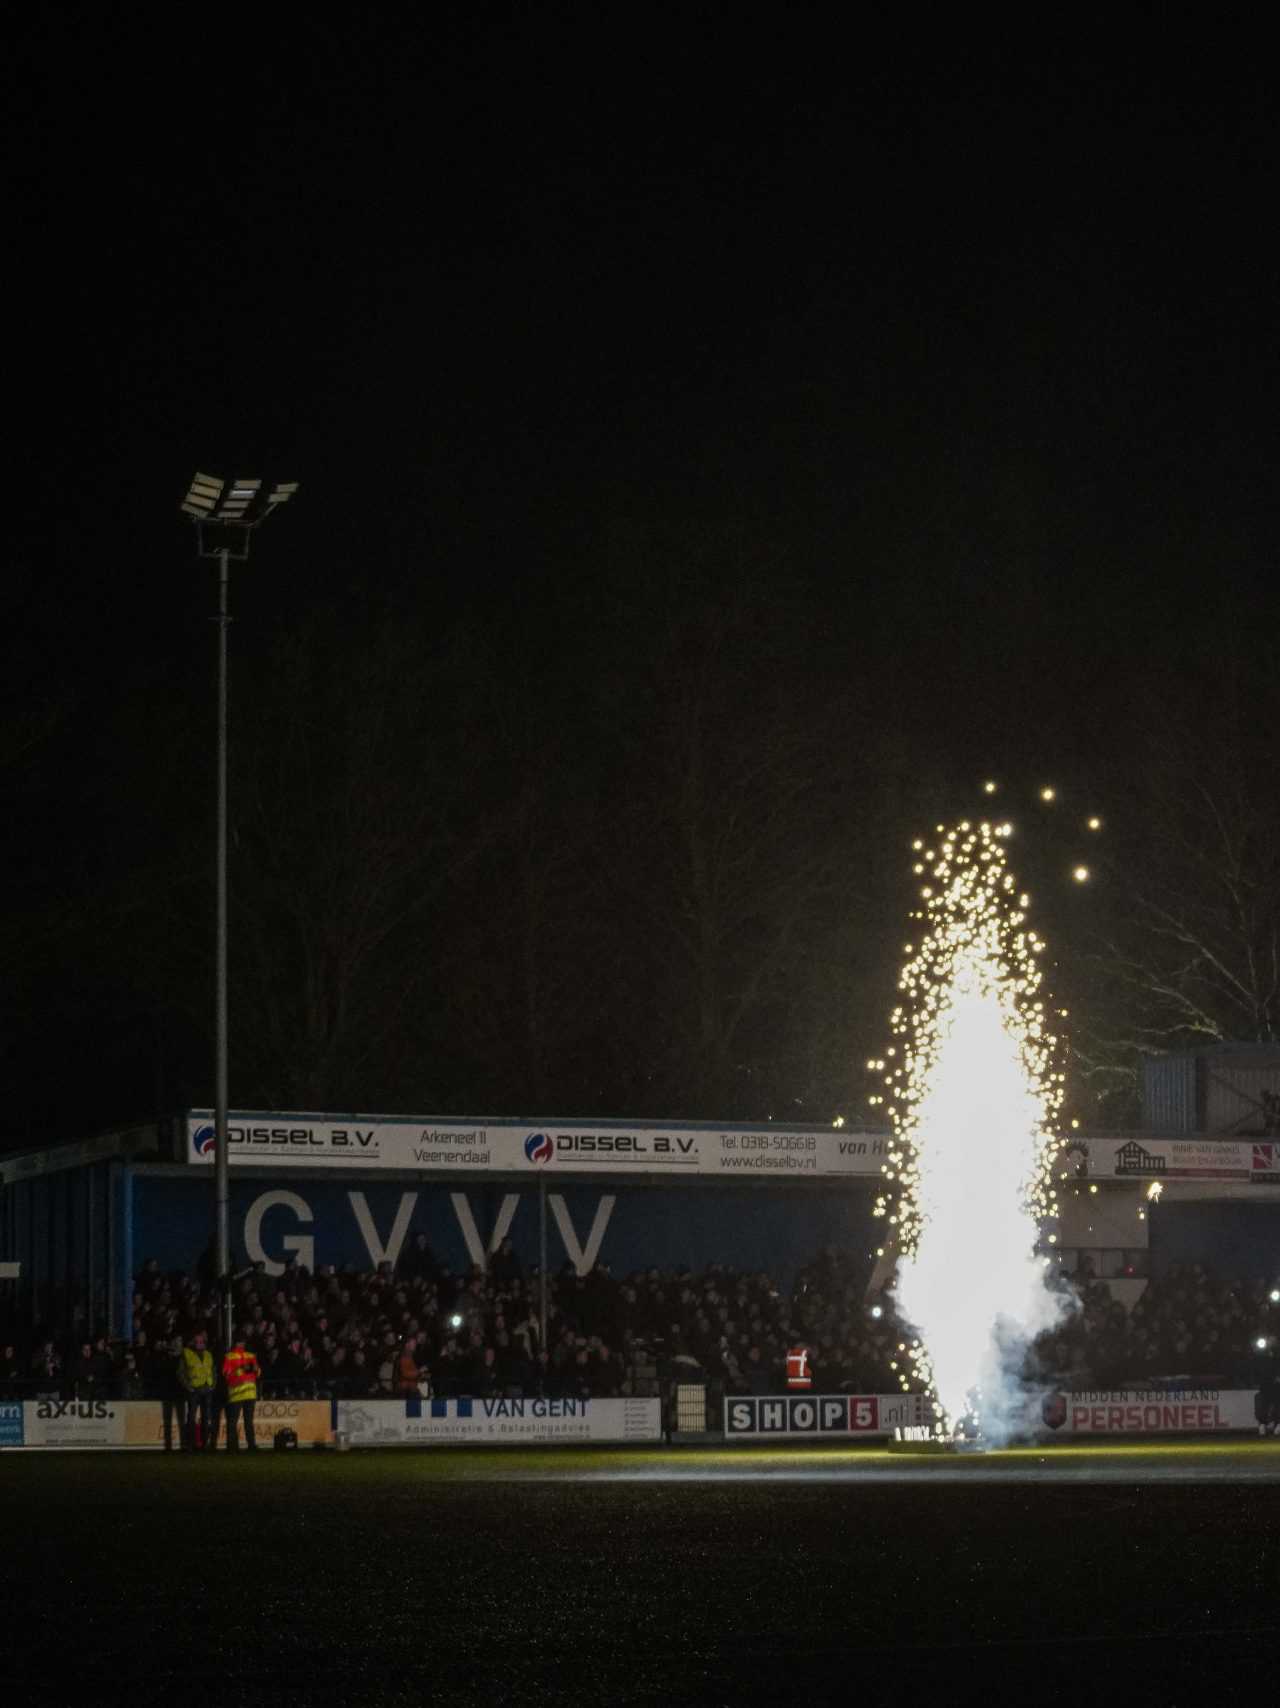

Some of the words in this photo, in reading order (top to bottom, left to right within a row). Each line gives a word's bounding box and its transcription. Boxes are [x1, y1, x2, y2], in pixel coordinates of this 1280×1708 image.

[227, 1129, 324, 1145] DISSEL
[331, 1130, 380, 1147] B.V.
[420, 1129, 476, 1145] Arkeneel
[556, 1135, 647, 1151] DISSEL
[653, 1137, 699, 1153] B.V.
[413, 1148, 490, 1164] Veenendaal
[719, 1154, 817, 1169] www.disselbv.nl
[1135, 1391, 1221, 1402] NEDERLAND
[482, 1398, 525, 1418] VAN
[532, 1398, 587, 1418] GENT
[1072, 1404, 1230, 1431] PERSONEEL
